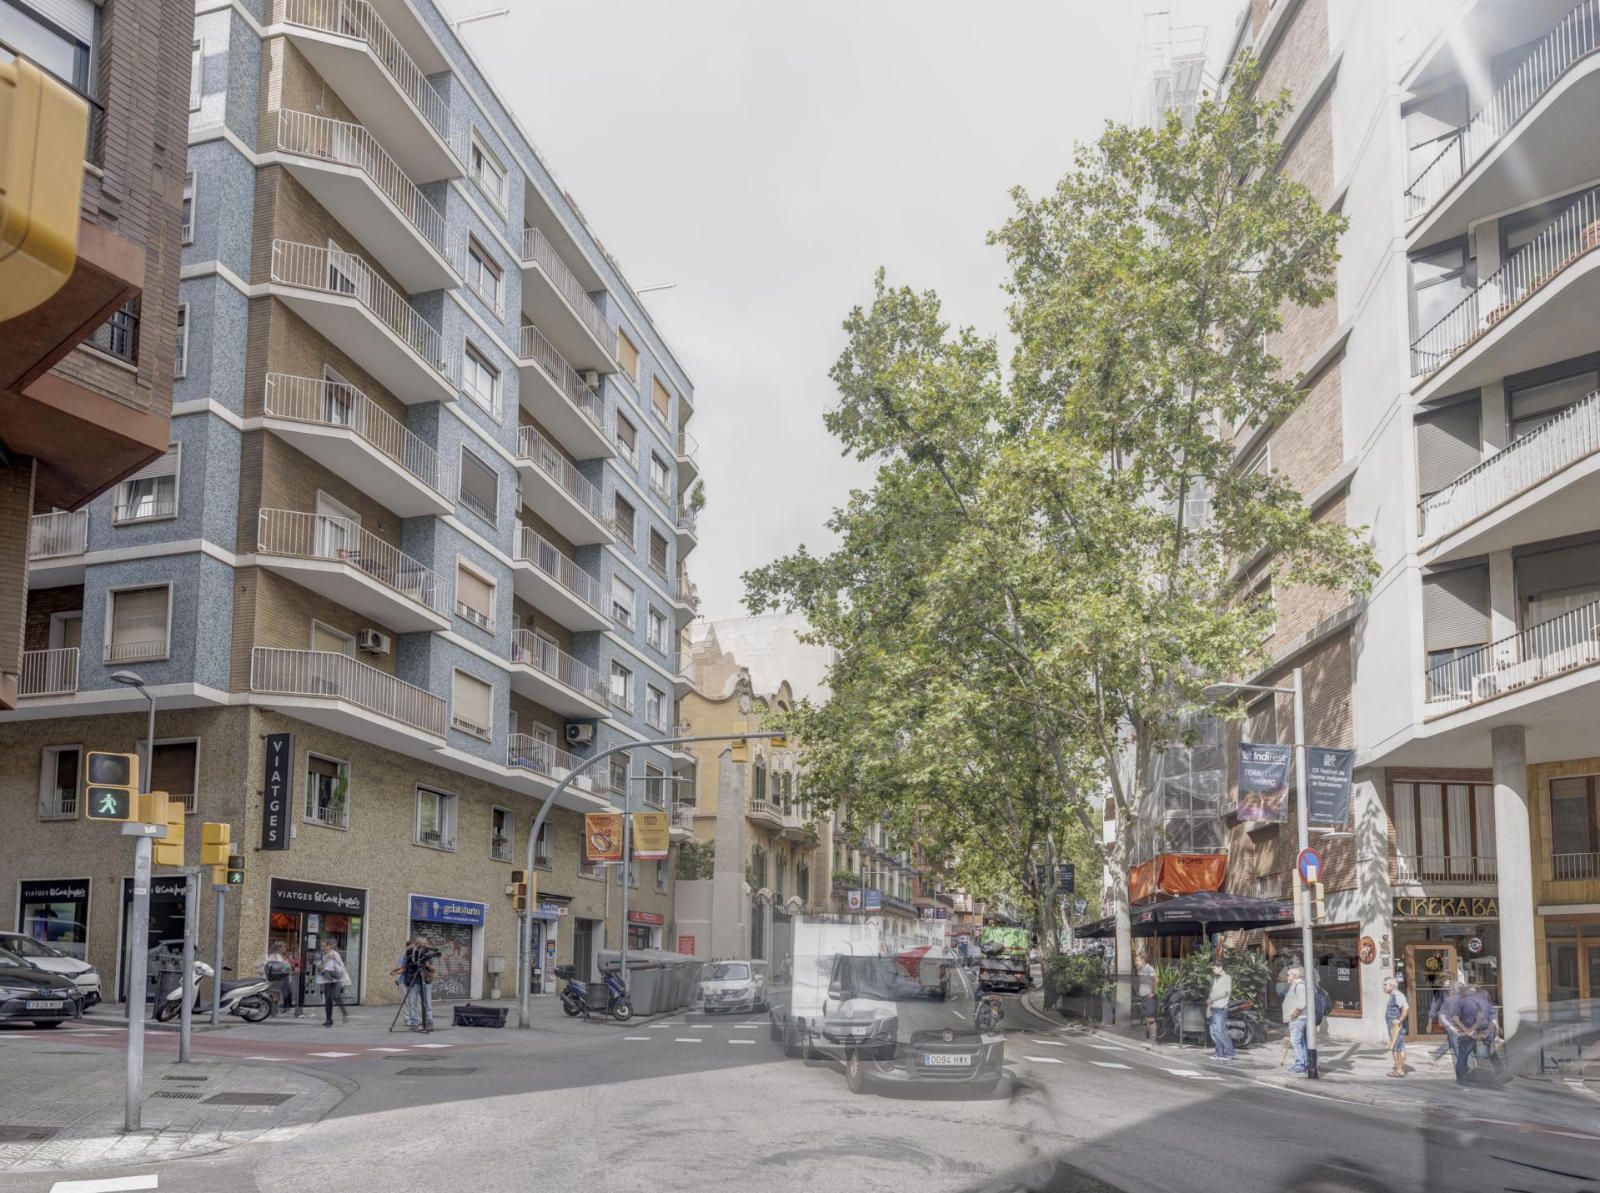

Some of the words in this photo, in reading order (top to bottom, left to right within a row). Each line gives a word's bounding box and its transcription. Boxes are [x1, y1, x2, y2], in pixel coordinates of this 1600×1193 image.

[269, 741, 283, 842] VIATGES
[277, 890, 312, 902] VIATGES
[1472, 897, 1499, 916] BA
